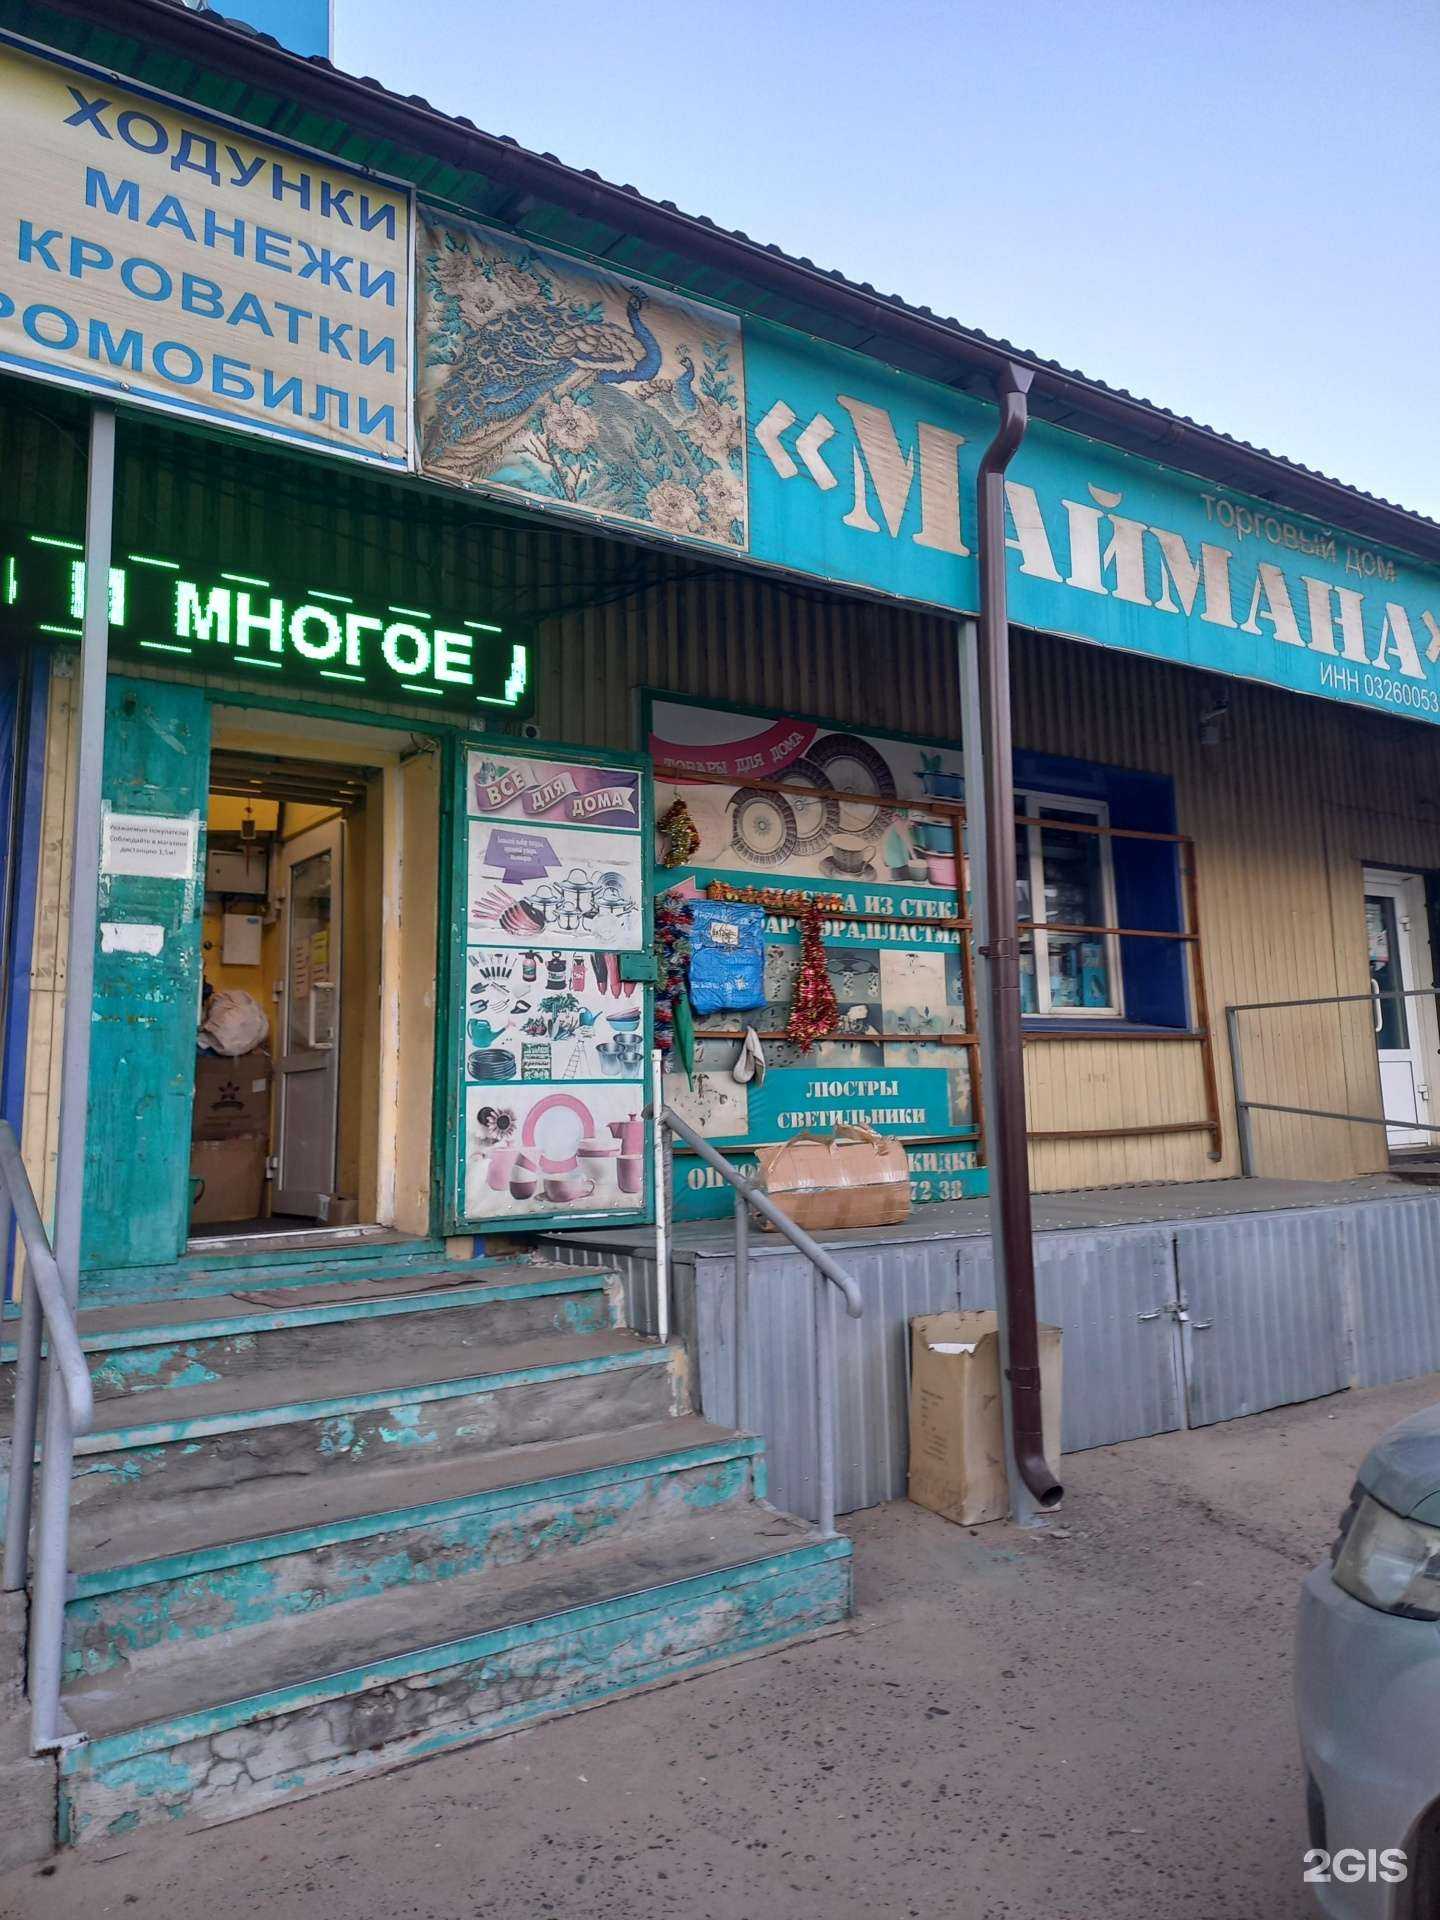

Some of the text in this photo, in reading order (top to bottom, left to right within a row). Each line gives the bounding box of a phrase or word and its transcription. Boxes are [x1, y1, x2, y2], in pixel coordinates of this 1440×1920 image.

[63, 86, 396, 241] ХОДУНКИ
[85, 166, 396, 307] МАНЕЖИ
[17, 219, 396, 374] КРОВАТКИ
[175, 580, 473, 685] МНОГОЕ
[1320, 661, 1440, 713] ИНН 03260053
[735, 752, 765, 773] ДЛЯ
[769, 731, 805, 762] ДОМА
[486, 769, 623, 817] ВСЕ ДЛЯ ДОМА
[863, 895, 894, 915] ИЗ
[900, 899, 974, 919] СТЕК
[806, 1080, 898, 1098] ЛЮСТРЫ
[777, 1108, 926, 1129] СВЕТИЛЬНИКИ
[940, 1180, 962, 1200] 38
